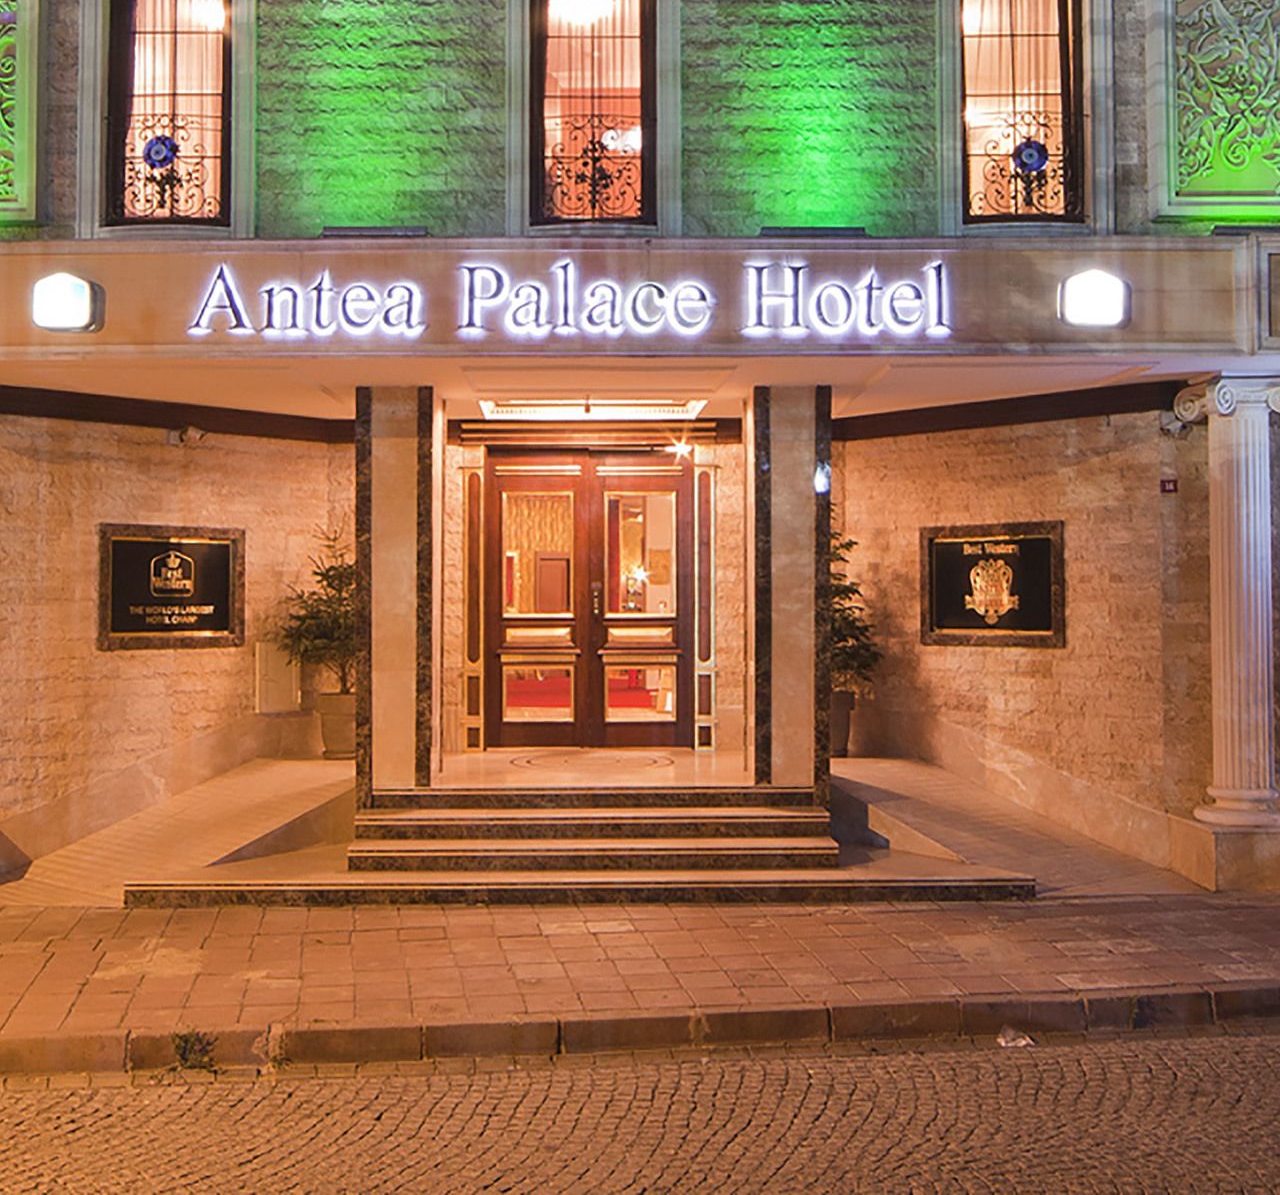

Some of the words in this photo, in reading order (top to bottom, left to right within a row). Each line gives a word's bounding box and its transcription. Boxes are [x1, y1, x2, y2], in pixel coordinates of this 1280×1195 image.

[186, 262, 429, 338] Antea
[457, 259, 717, 338] Palace
[738, 259, 952, 338] Hotel
